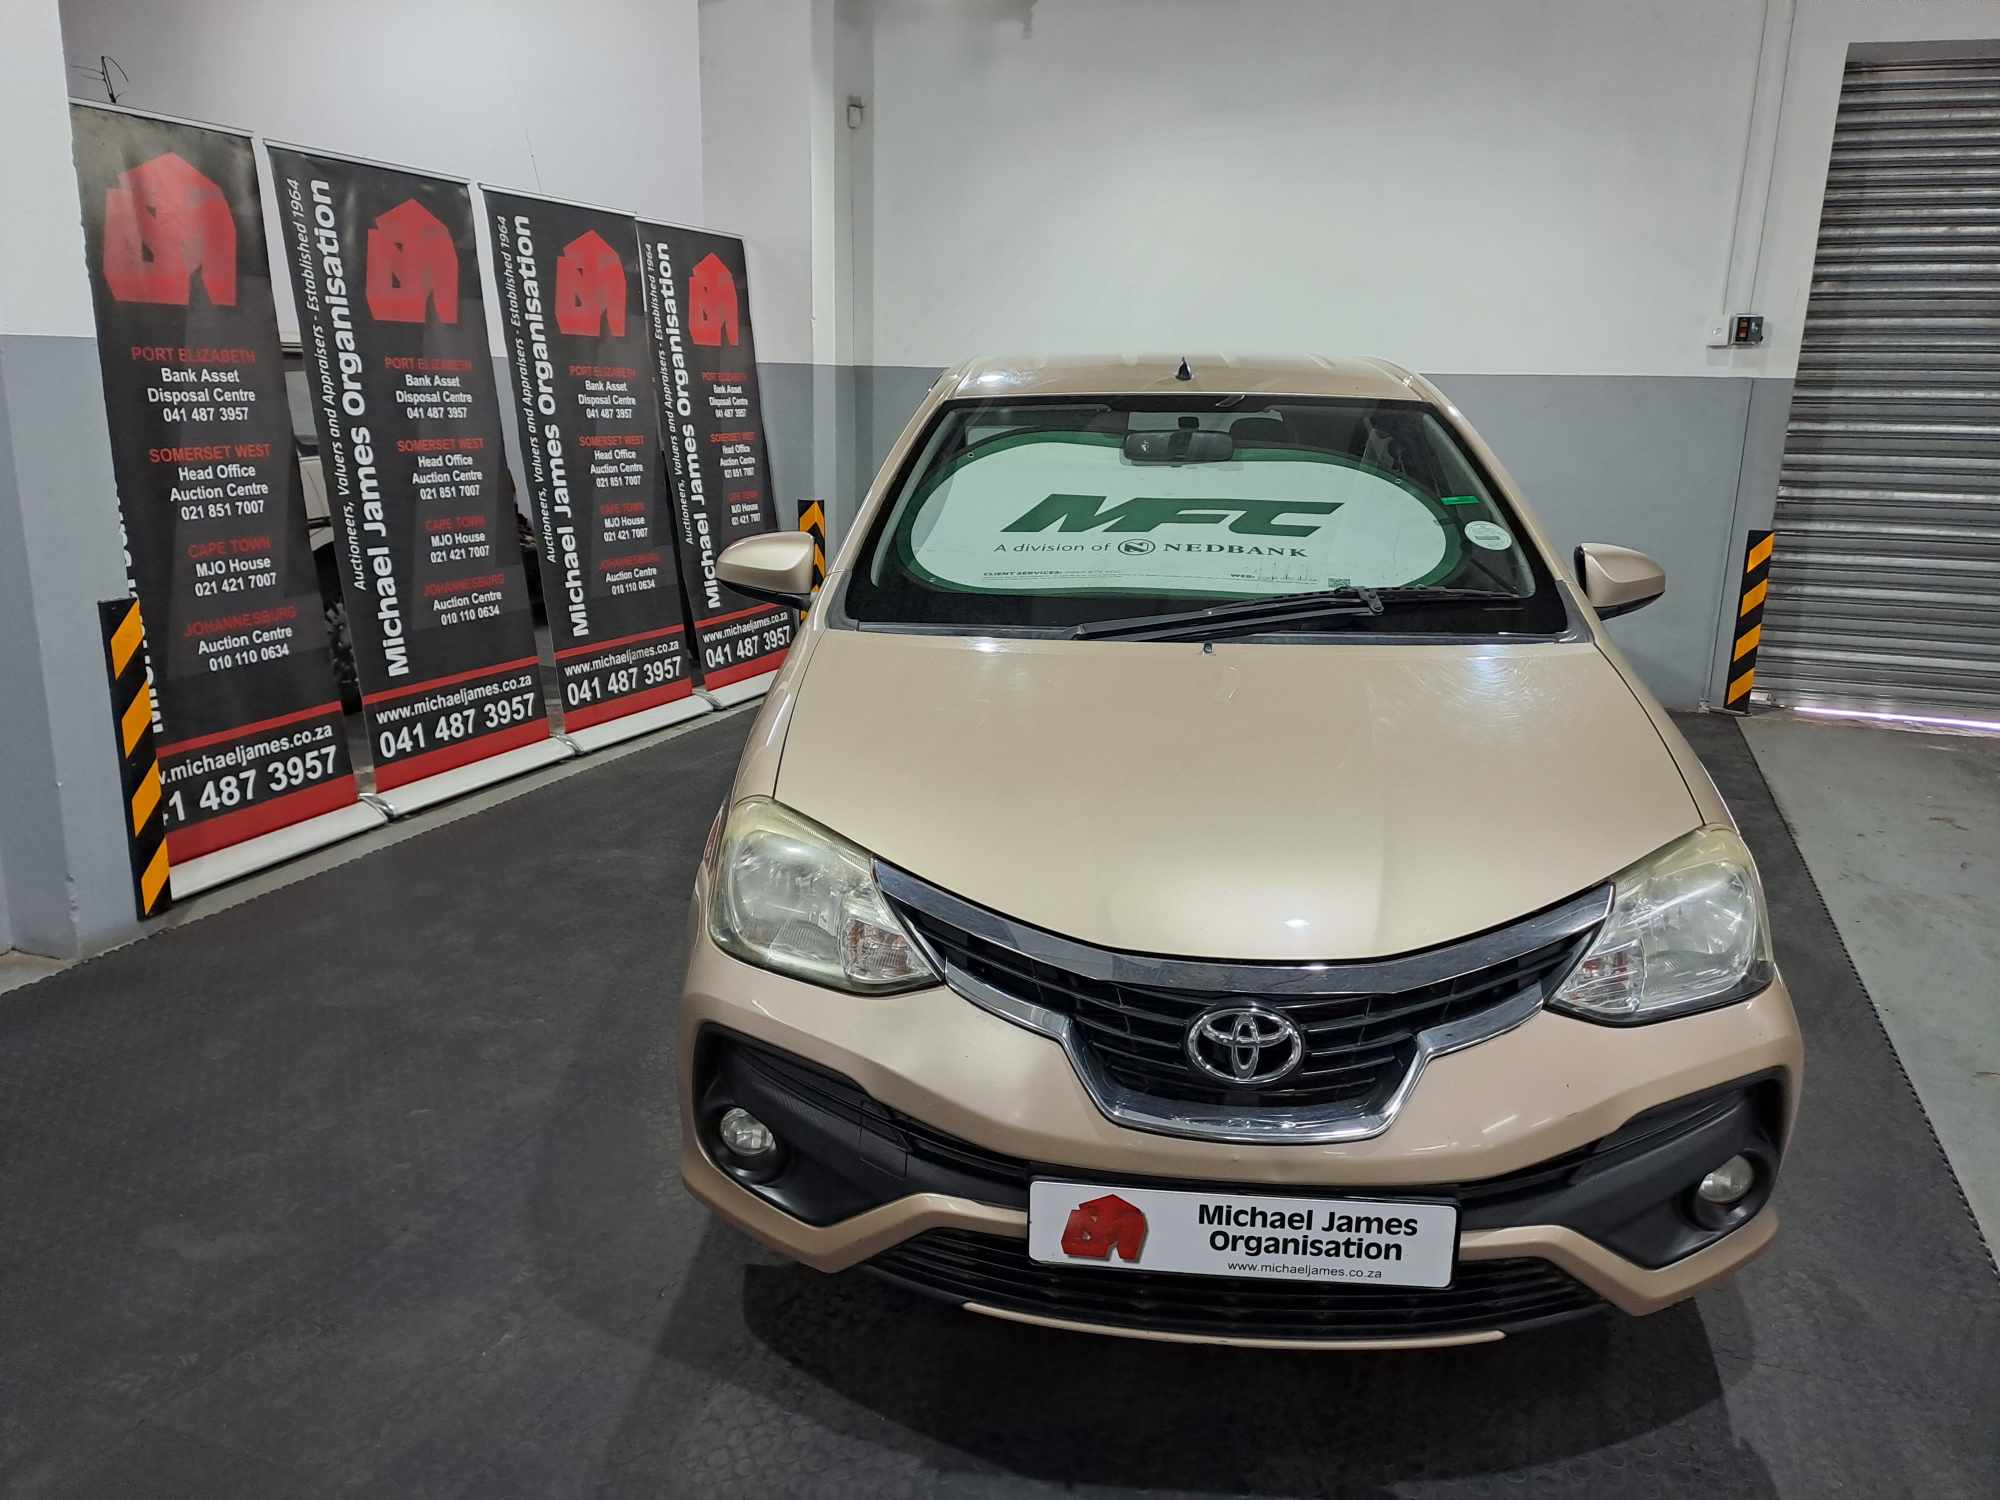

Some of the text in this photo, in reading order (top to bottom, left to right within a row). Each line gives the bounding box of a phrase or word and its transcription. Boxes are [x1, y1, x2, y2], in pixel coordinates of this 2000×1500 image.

[649, 274, 664, 341] Established
[131, 347, 256, 363] PORT ELIZABETH
[161, 368, 239, 382] Bank Asset
[287, 178, 366, 591] Auctioneers, Valuers and Appraisers Established 1964
[405, 374, 460, 387] Bank Asset
[659, 350, 672, 409] Appraisers
[497, 216, 556, 564] Auctioneers, Valuers and Appraisers Established 1964
[585, 380, 627, 391] Bank Asset
[148, 388, 255, 404] Disposal Centre
[396, 391, 472, 405] Disposal Centre
[578, 394, 636, 406] Disposal Centre
[163, 407, 248, 422] 041 487 3957
[407, 407, 467, 419] 041 487 3957
[664, 410, 675, 432] and
[310, 179, 410, 678] Michael James Organisation
[514, 216, 589, 636] Michael James Organisation
[657, 243, 720, 608] Michael James Organisation
[150, 444, 271, 462] SOMERSET WEST
[418, 454, 473, 467] Head Office
[594, 449, 636, 460] Head Office
[668, 435, 682, 476] Valuers
[178, 464, 256, 481] Head Office
[412, 470, 483, 484] Auction Centre
[590, 463, 643, 474] Auction Centre
[170, 483, 268, 501] Auction Centre
[420, 485, 480, 500] 021 851 7007
[181, 500, 264, 520] 021 851 7007
[1000, 493, 1345, 537] MFC
[188, 537, 270, 558] CAPE TOWN
[431, 532, 485, 546] MJO House
[431, 546, 489, 563] 021 421 7007
[994, 544, 1006, 552] A
[1014, 542, 1084, 552] division
[1091, 542, 1110, 552] of
[1164, 543, 1308, 557] NEDBANK
[196, 558, 270, 577] MJO House
[606, 567, 656, 582] Auction Centre
[195, 573, 277, 597] 021 421 7007
[433, 591, 502, 611] Auction Centre
[441, 605, 499, 625] 010 110 0634
[703, 611, 788, 642] www.michaeljames.co.za
[199, 626, 292, 655] Auction Centre
[706, 625, 791, 668] 041 487 3957
[209, 643, 289, 671] 010 110 0634
[564, 640, 679, 676] www.michaeljames.co.za
[567, 656, 681, 705] 041 487 3957
[376, 675, 532, 724] www.michaeljames.co.za
[380, 693, 535, 758] 041 487 3957
[200, 769, 257, 811] 487
[268, 745, 337, 792] 3957
[1199, 1204, 1417, 1236] Michael James
[1209, 1231, 1402, 1260] Organisation
[1228, 1262, 1382, 1278] www.michaeljames.co.za
